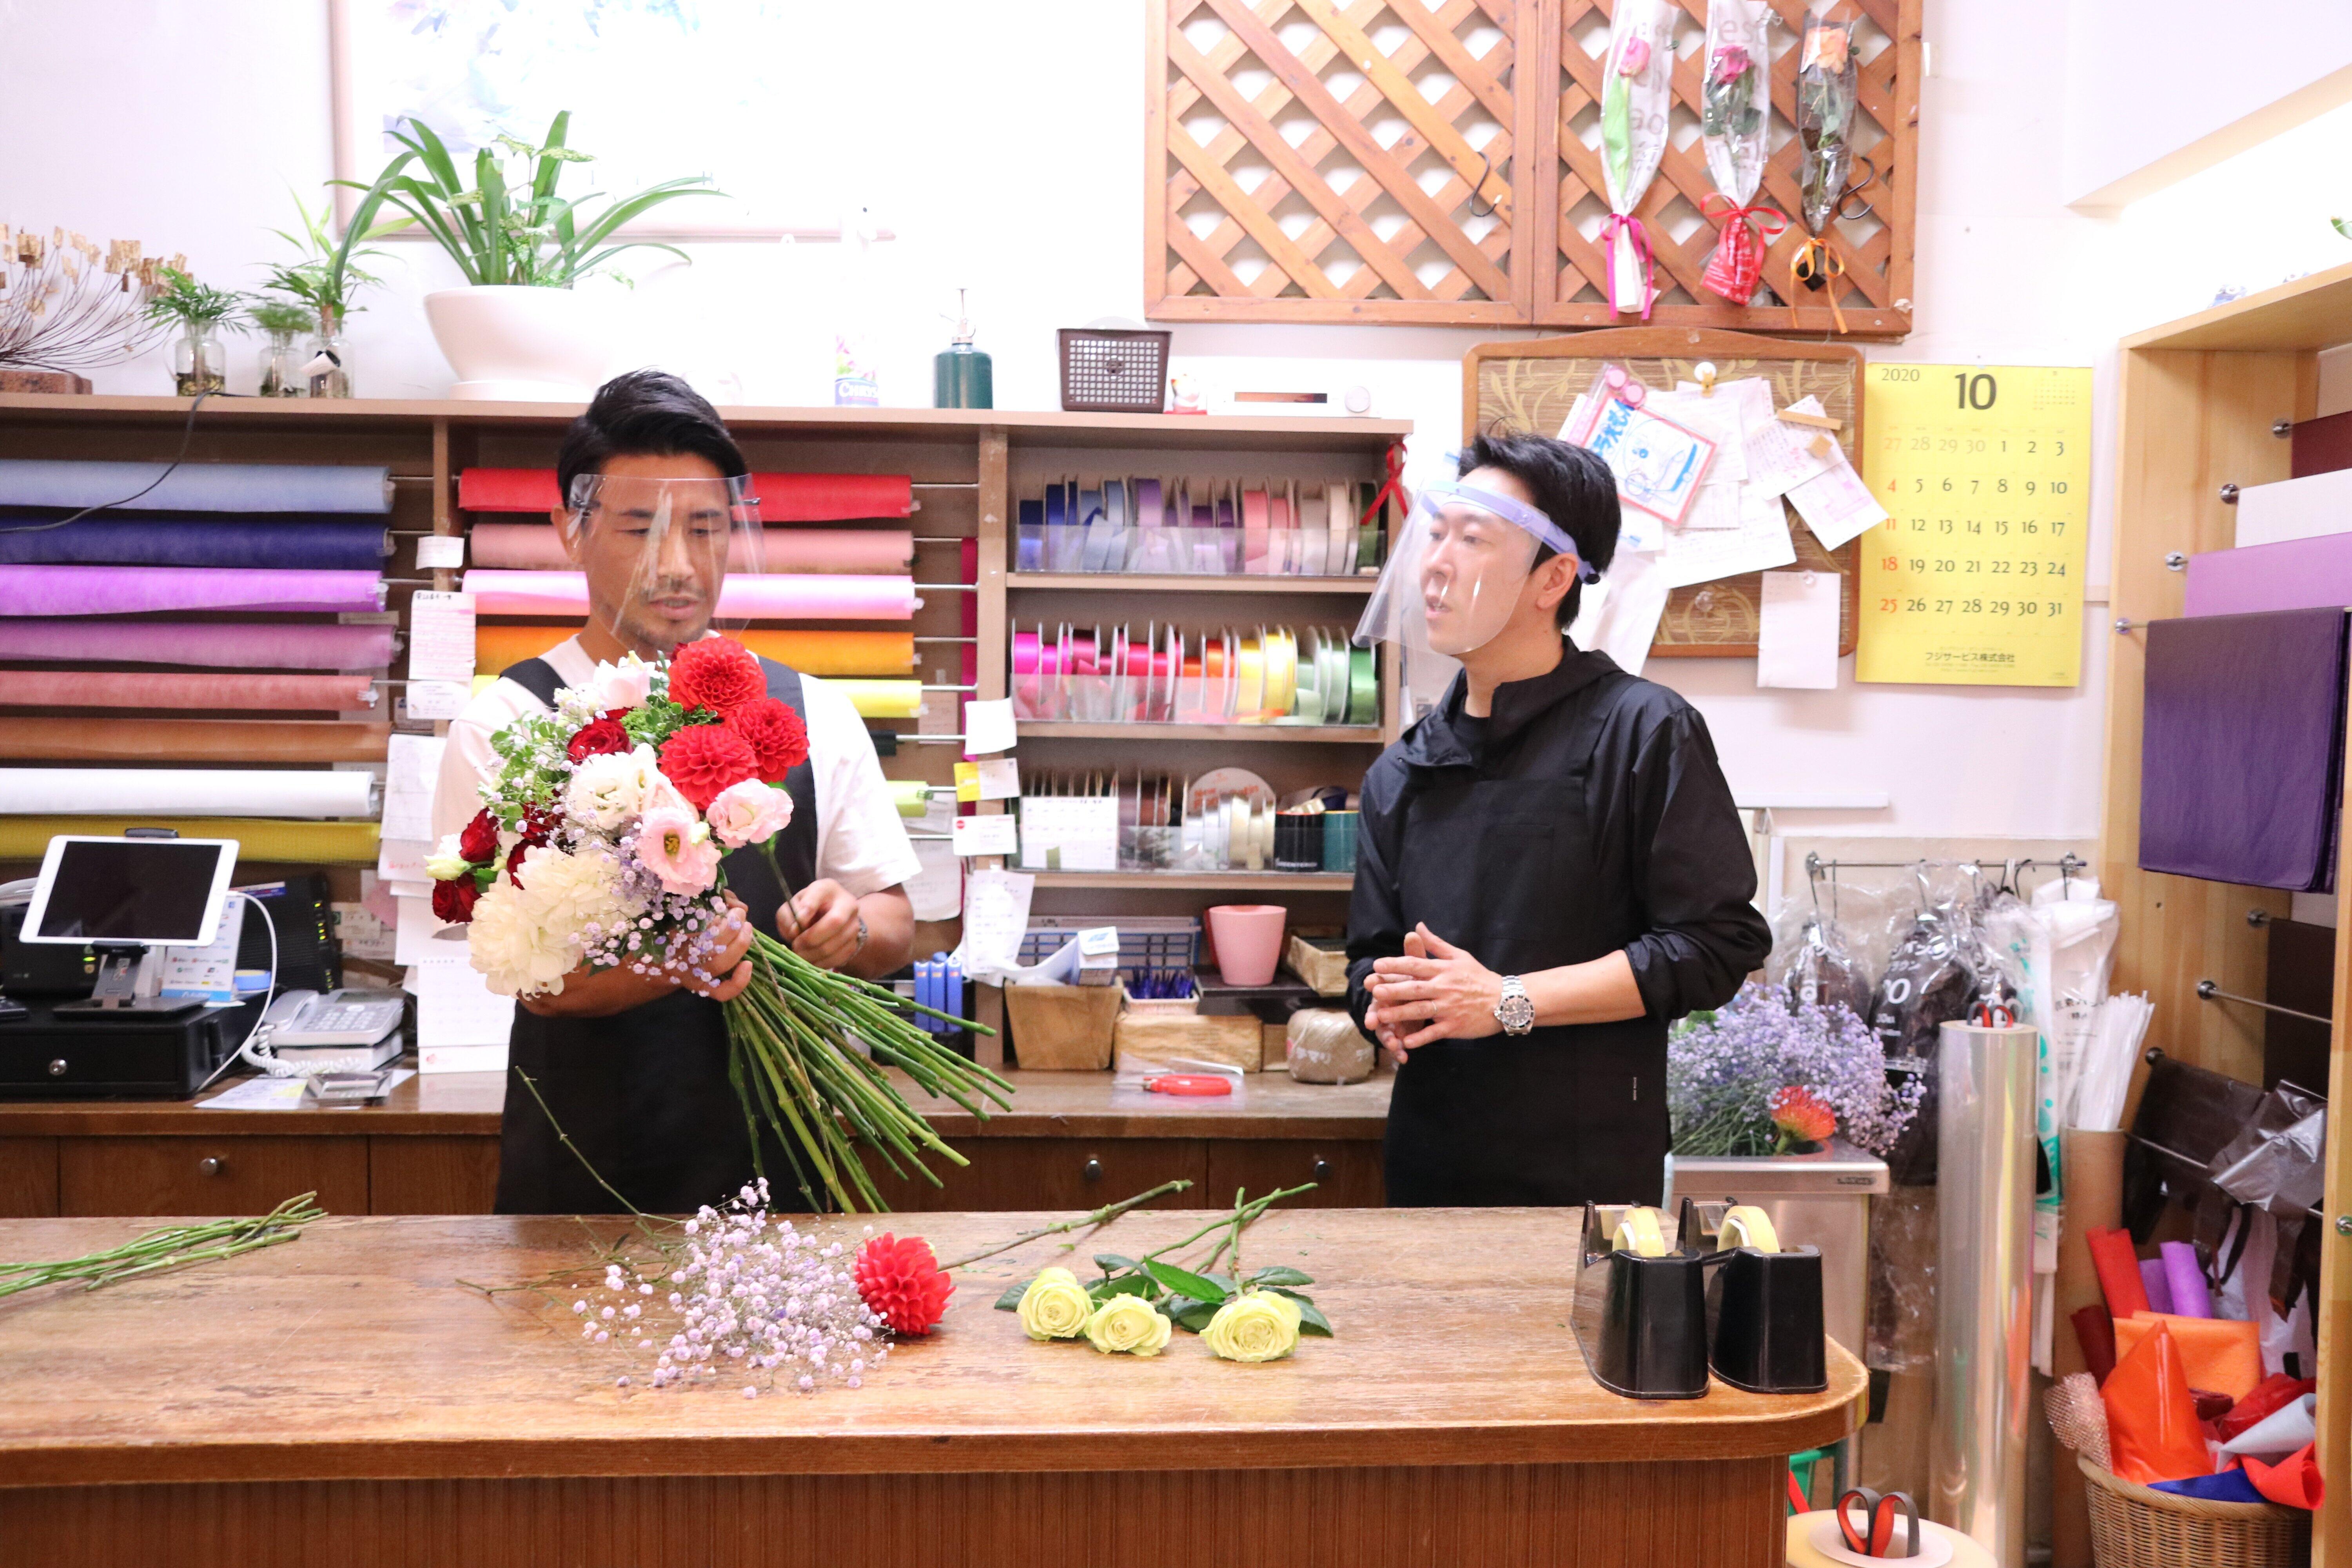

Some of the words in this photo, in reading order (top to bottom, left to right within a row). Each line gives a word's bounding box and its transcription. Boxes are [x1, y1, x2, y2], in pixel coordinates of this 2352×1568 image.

[1882, 368, 1920, 381] 2020
[1955, 373, 1996, 410] 10
[1883, 438, 1901, 452] 27
[1911, 437, 1930, 450] 28
[1939, 439, 1958, 453] 29
[1966, 439, 1986, 454] 30
[2002, 441, 2006, 452] 1
[2028, 441, 2036, 453] 2
[2056, 441, 2064, 456] 3
[1887, 479, 1896, 492] 4
[1916, 479, 1923, 493] 5
[1942, 478, 1952, 491] 6
[1971, 480, 1979, 494] 7
[1998, 479, 2008, 493] 8
[2026, 481, 2035, 495] 9
[2051, 482, 2067, 494] 10
[1886, 518, 1896, 530] 11
[1912, 519, 1926, 531] 12
[1940, 520, 1953, 534] 13
[1967, 521, 1981, 535] 14
[1995, 521, 2008, 535] 15
[2022, 520, 2038, 534] 16
[2051, 522, 2065, 536] 17
[1882, 557, 1898, 571] 18
[1909, 559, 1925, 573] 19
[1935, 560, 1955, 572] 20
[1966, 561, 1980, 572] 21
[1992, 561, 2010, 573] 22
[2020, 562, 2038, 576] 23
[2048, 562, 2065, 577] 24
[1880, 598, 1897, 613] 25
[1907, 598, 1926, 611] 26
[1936, 600, 1953, 614] 27
[1962, 599, 1982, 613] 28
[1990, 601, 2009, 615] 29
[2018, 602, 2037, 616] 30
[2048, 603, 2062, 617] 31
